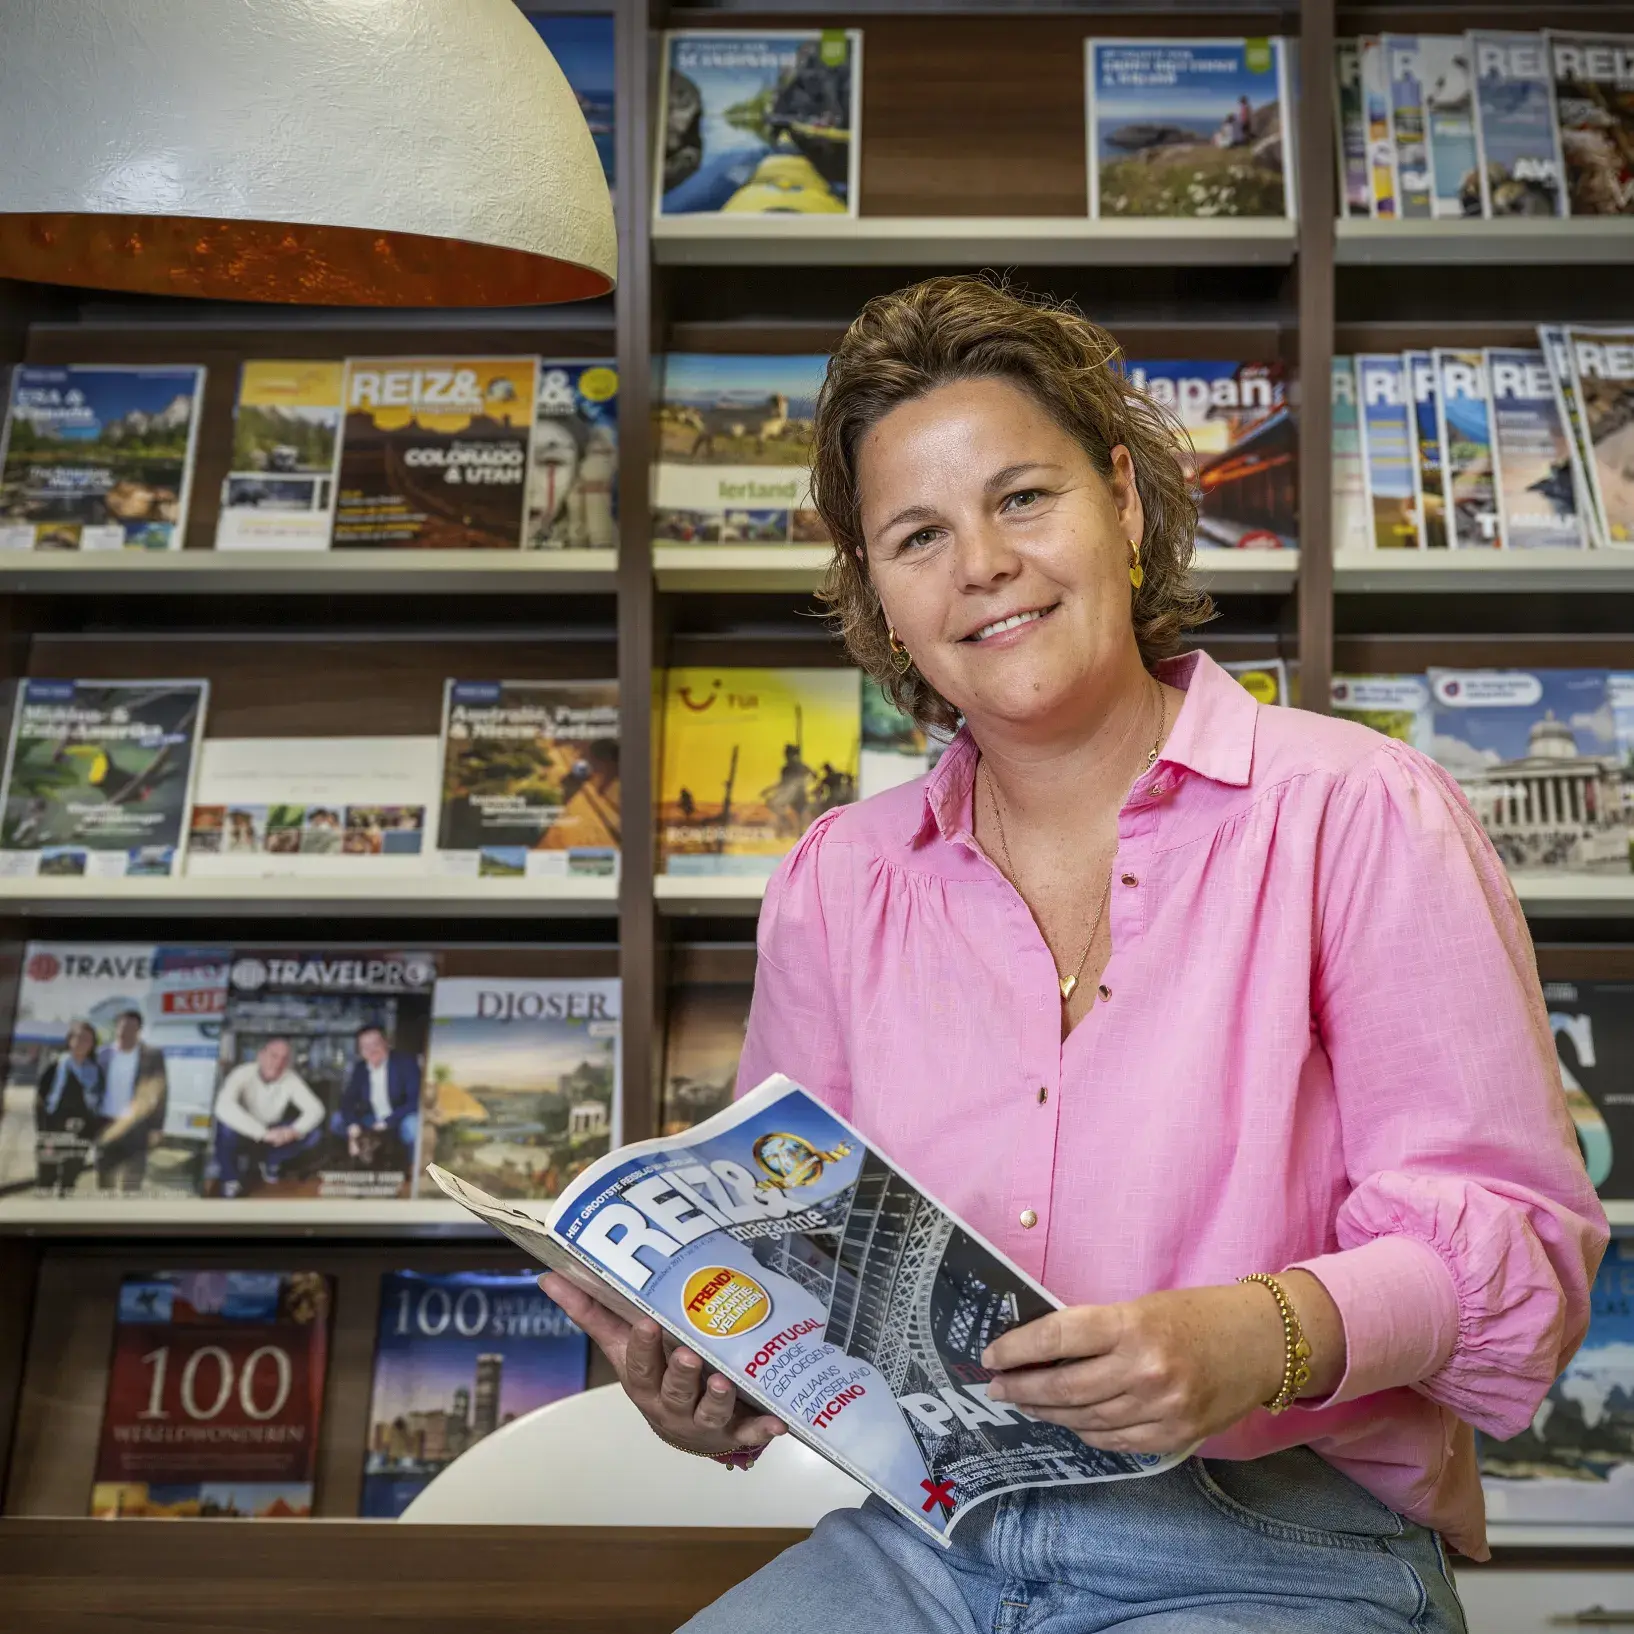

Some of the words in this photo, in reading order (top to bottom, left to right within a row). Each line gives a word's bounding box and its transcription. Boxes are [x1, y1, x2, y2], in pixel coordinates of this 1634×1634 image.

[352, 368, 484, 406] REIZ&
[404, 447, 525, 466] COLORADO
[444, 468, 463, 483] &
[465, 468, 523, 484] UTAH
[476, 990, 616, 1022] DJOSER
[565, 1217, 583, 1240] HET
[580, 1181, 624, 1220] GROOTSTE
[575, 1159, 809, 1292] REIZ&
[726, 1208, 829, 1242] magazine
[581, 1254, 604, 1274] MAGAZINE
[394, 1288, 490, 1336] 100
[687, 1269, 736, 1314] TREND!
[704, 1281, 742, 1316] ONLINE
[717, 1291, 765, 1335] VEILINGEN
[744, 1317, 825, 1378] PORTUGAL
[759, 1342, 807, 1390] ZONDIGE
[136, 1345, 292, 1420] 100
[772, 1344, 836, 1399] GENOEGENS
[789, 1365, 841, 1413] ITALIAANS
[801, 1366, 871, 1424] ZWITSERLAND
[812, 1383, 866, 1430] TICINO
[959, 1467, 996, 1485] SALZBURG
